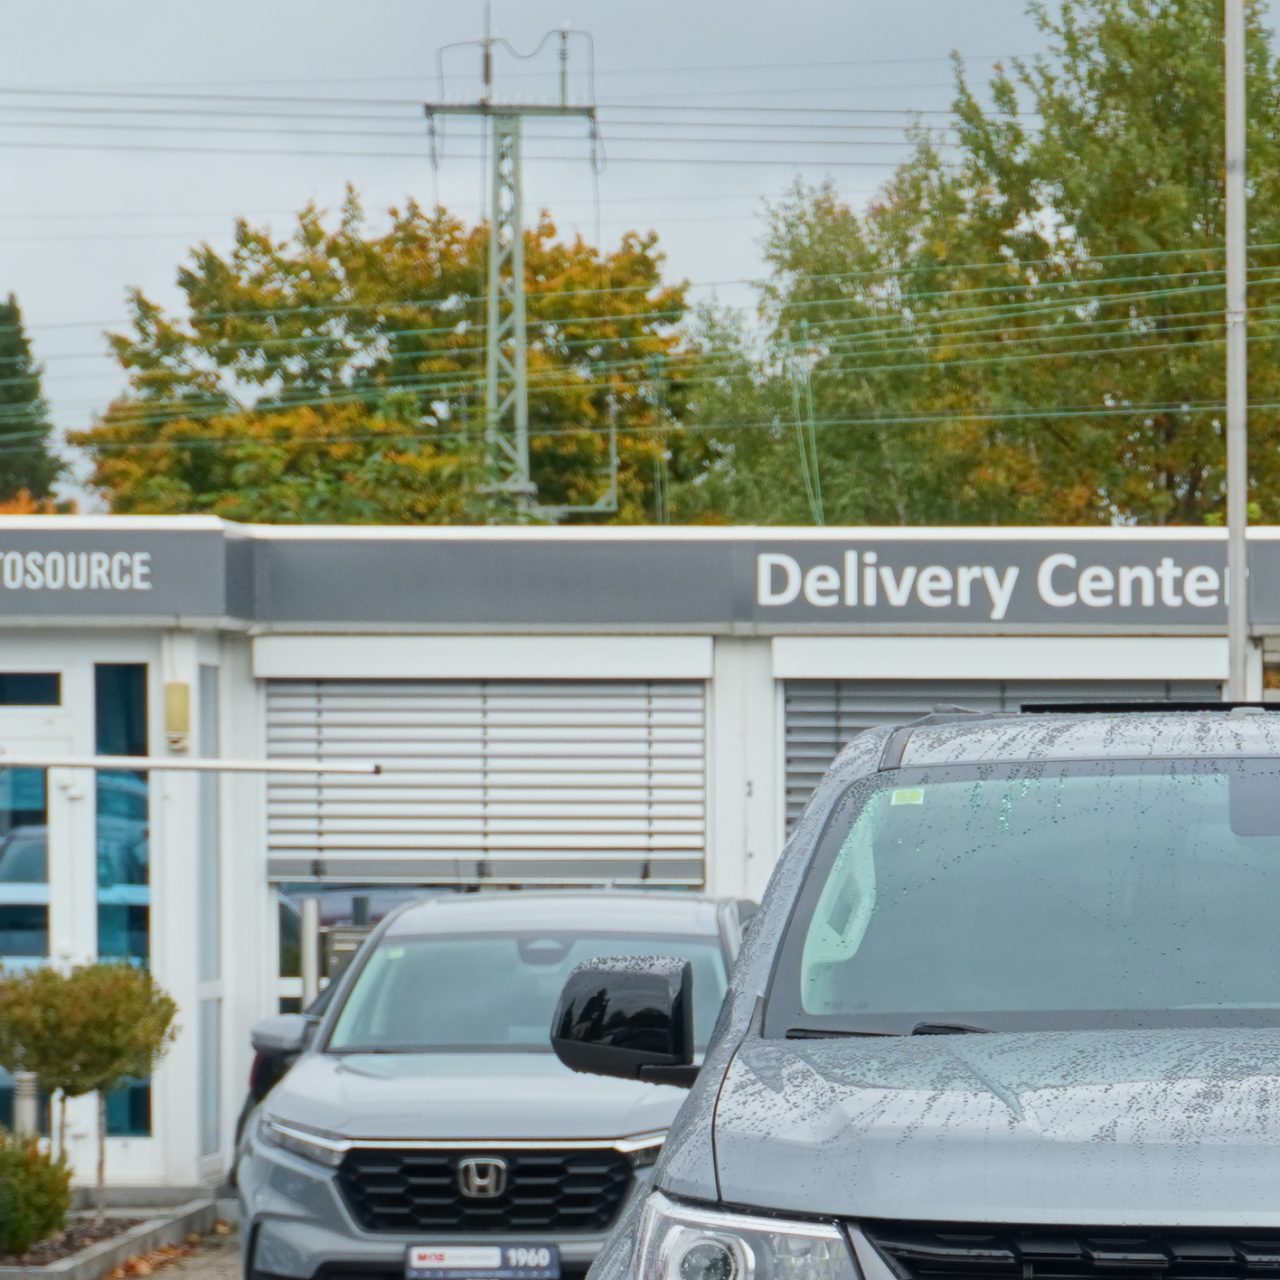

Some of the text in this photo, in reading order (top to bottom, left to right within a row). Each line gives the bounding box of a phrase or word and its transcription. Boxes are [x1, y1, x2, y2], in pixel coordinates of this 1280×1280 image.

[0, 551, 152, 590] OSOURCE
[757, 550, 1019, 620] Delivery
[507, 1248, 550, 1267] 1960
